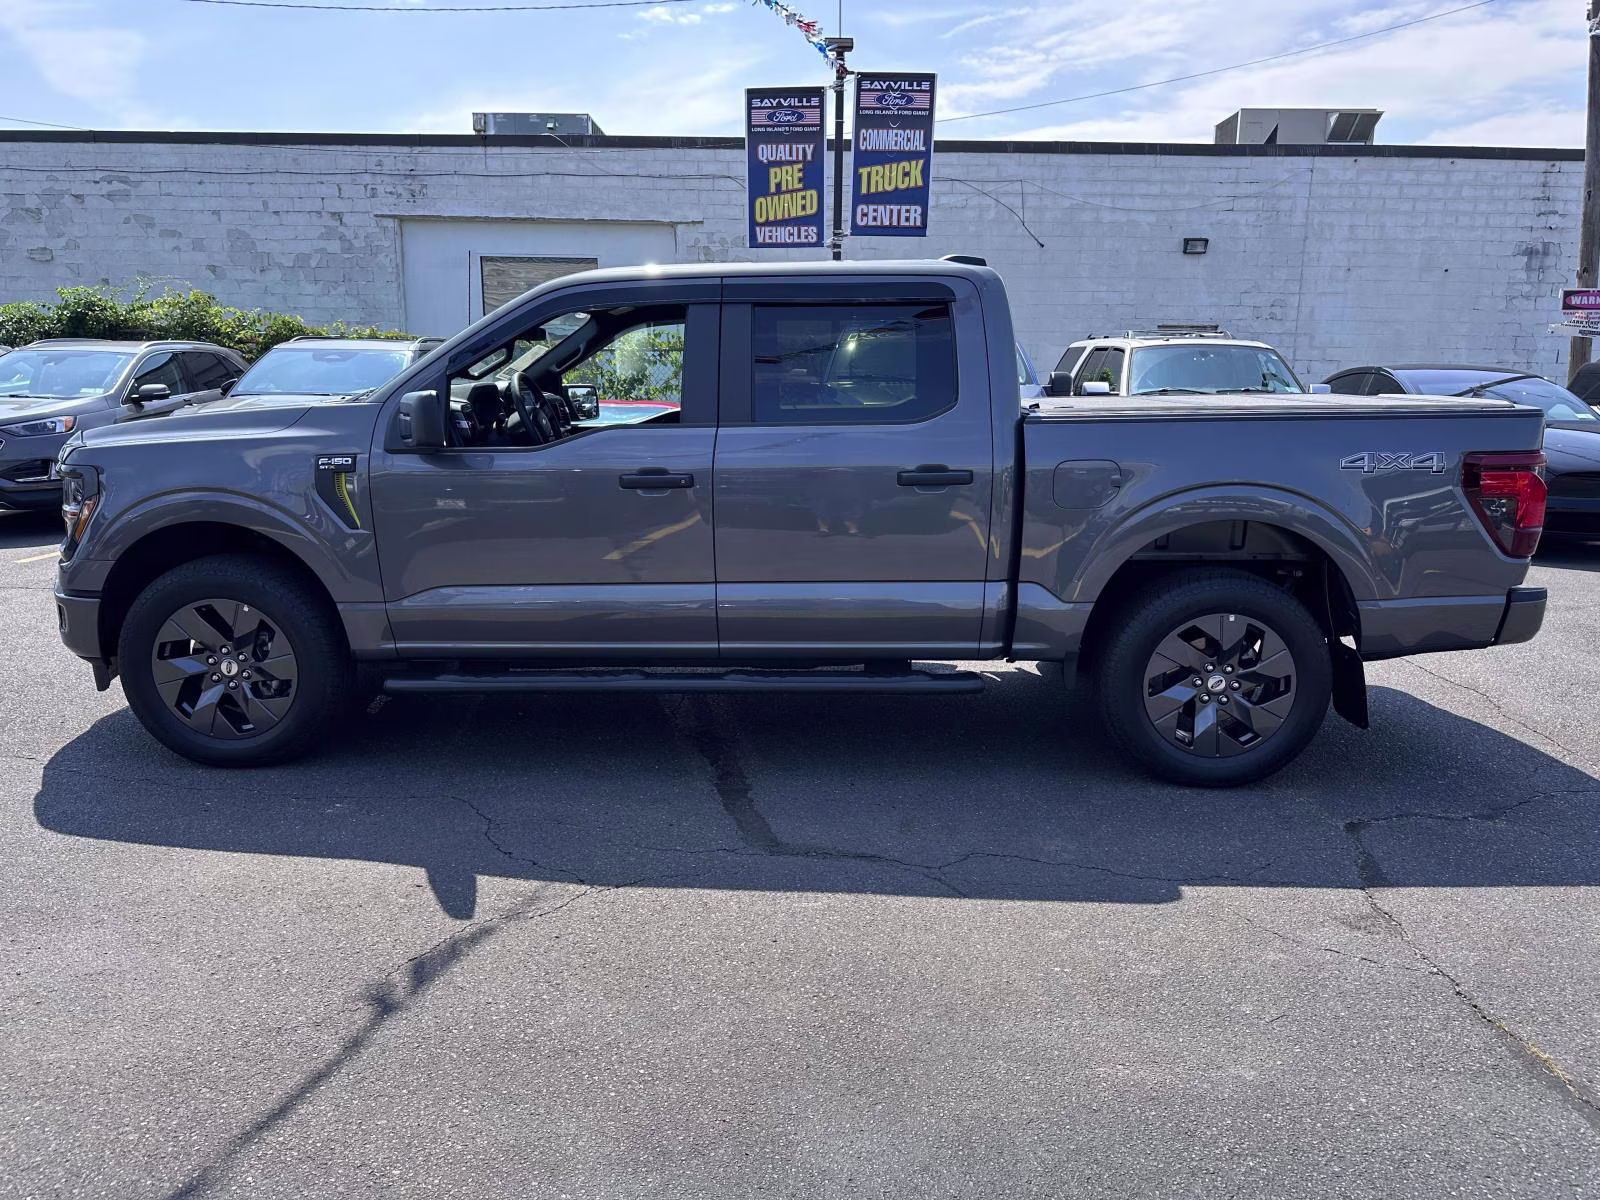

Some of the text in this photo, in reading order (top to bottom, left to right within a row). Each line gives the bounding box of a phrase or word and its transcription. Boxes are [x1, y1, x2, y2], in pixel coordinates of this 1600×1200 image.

[860, 80, 930, 90] SAYVILLE
[751, 97, 820, 107] SAYVILLE
[881, 94, 908, 105] Ford
[773, 110, 798, 122] Ford
[859, 128, 926, 152] COMMERCIAL
[758, 143, 815, 163] QUALITY
[769, 163, 804, 193] PRE
[858, 159, 926, 196] TRUCK
[755, 189, 818, 224] OWNED
[856, 204, 922, 227] CENTER
[755, 226, 817, 243] VEHICLES
[318, 457, 352, 465] F-150
